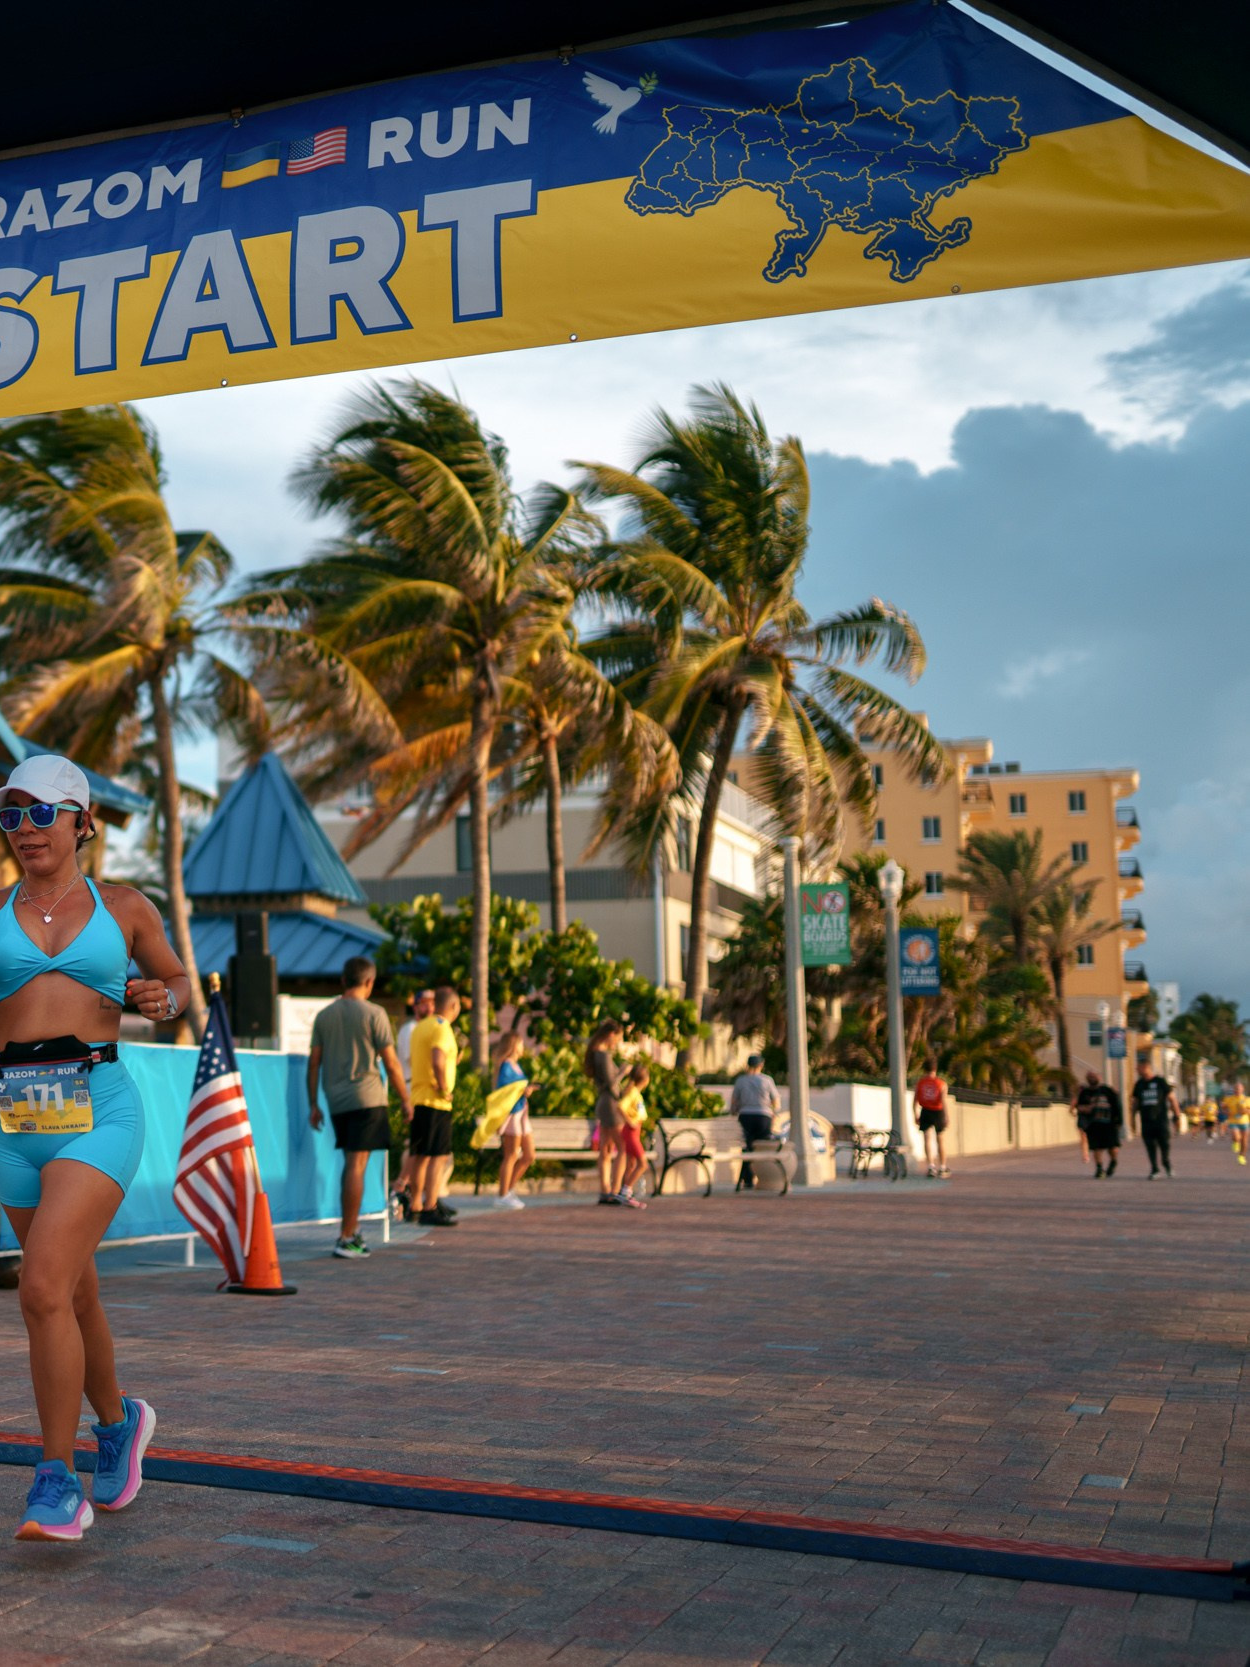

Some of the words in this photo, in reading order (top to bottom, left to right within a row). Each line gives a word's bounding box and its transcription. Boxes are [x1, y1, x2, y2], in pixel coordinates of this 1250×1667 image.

[367, 98, 531, 169] RUN
[803, 913, 847, 930] SKATE
[3, 1070, 37, 1079] RAZOM
[57, 1067, 78, 1075] RUN
[20, 1082, 65, 1112] 171
